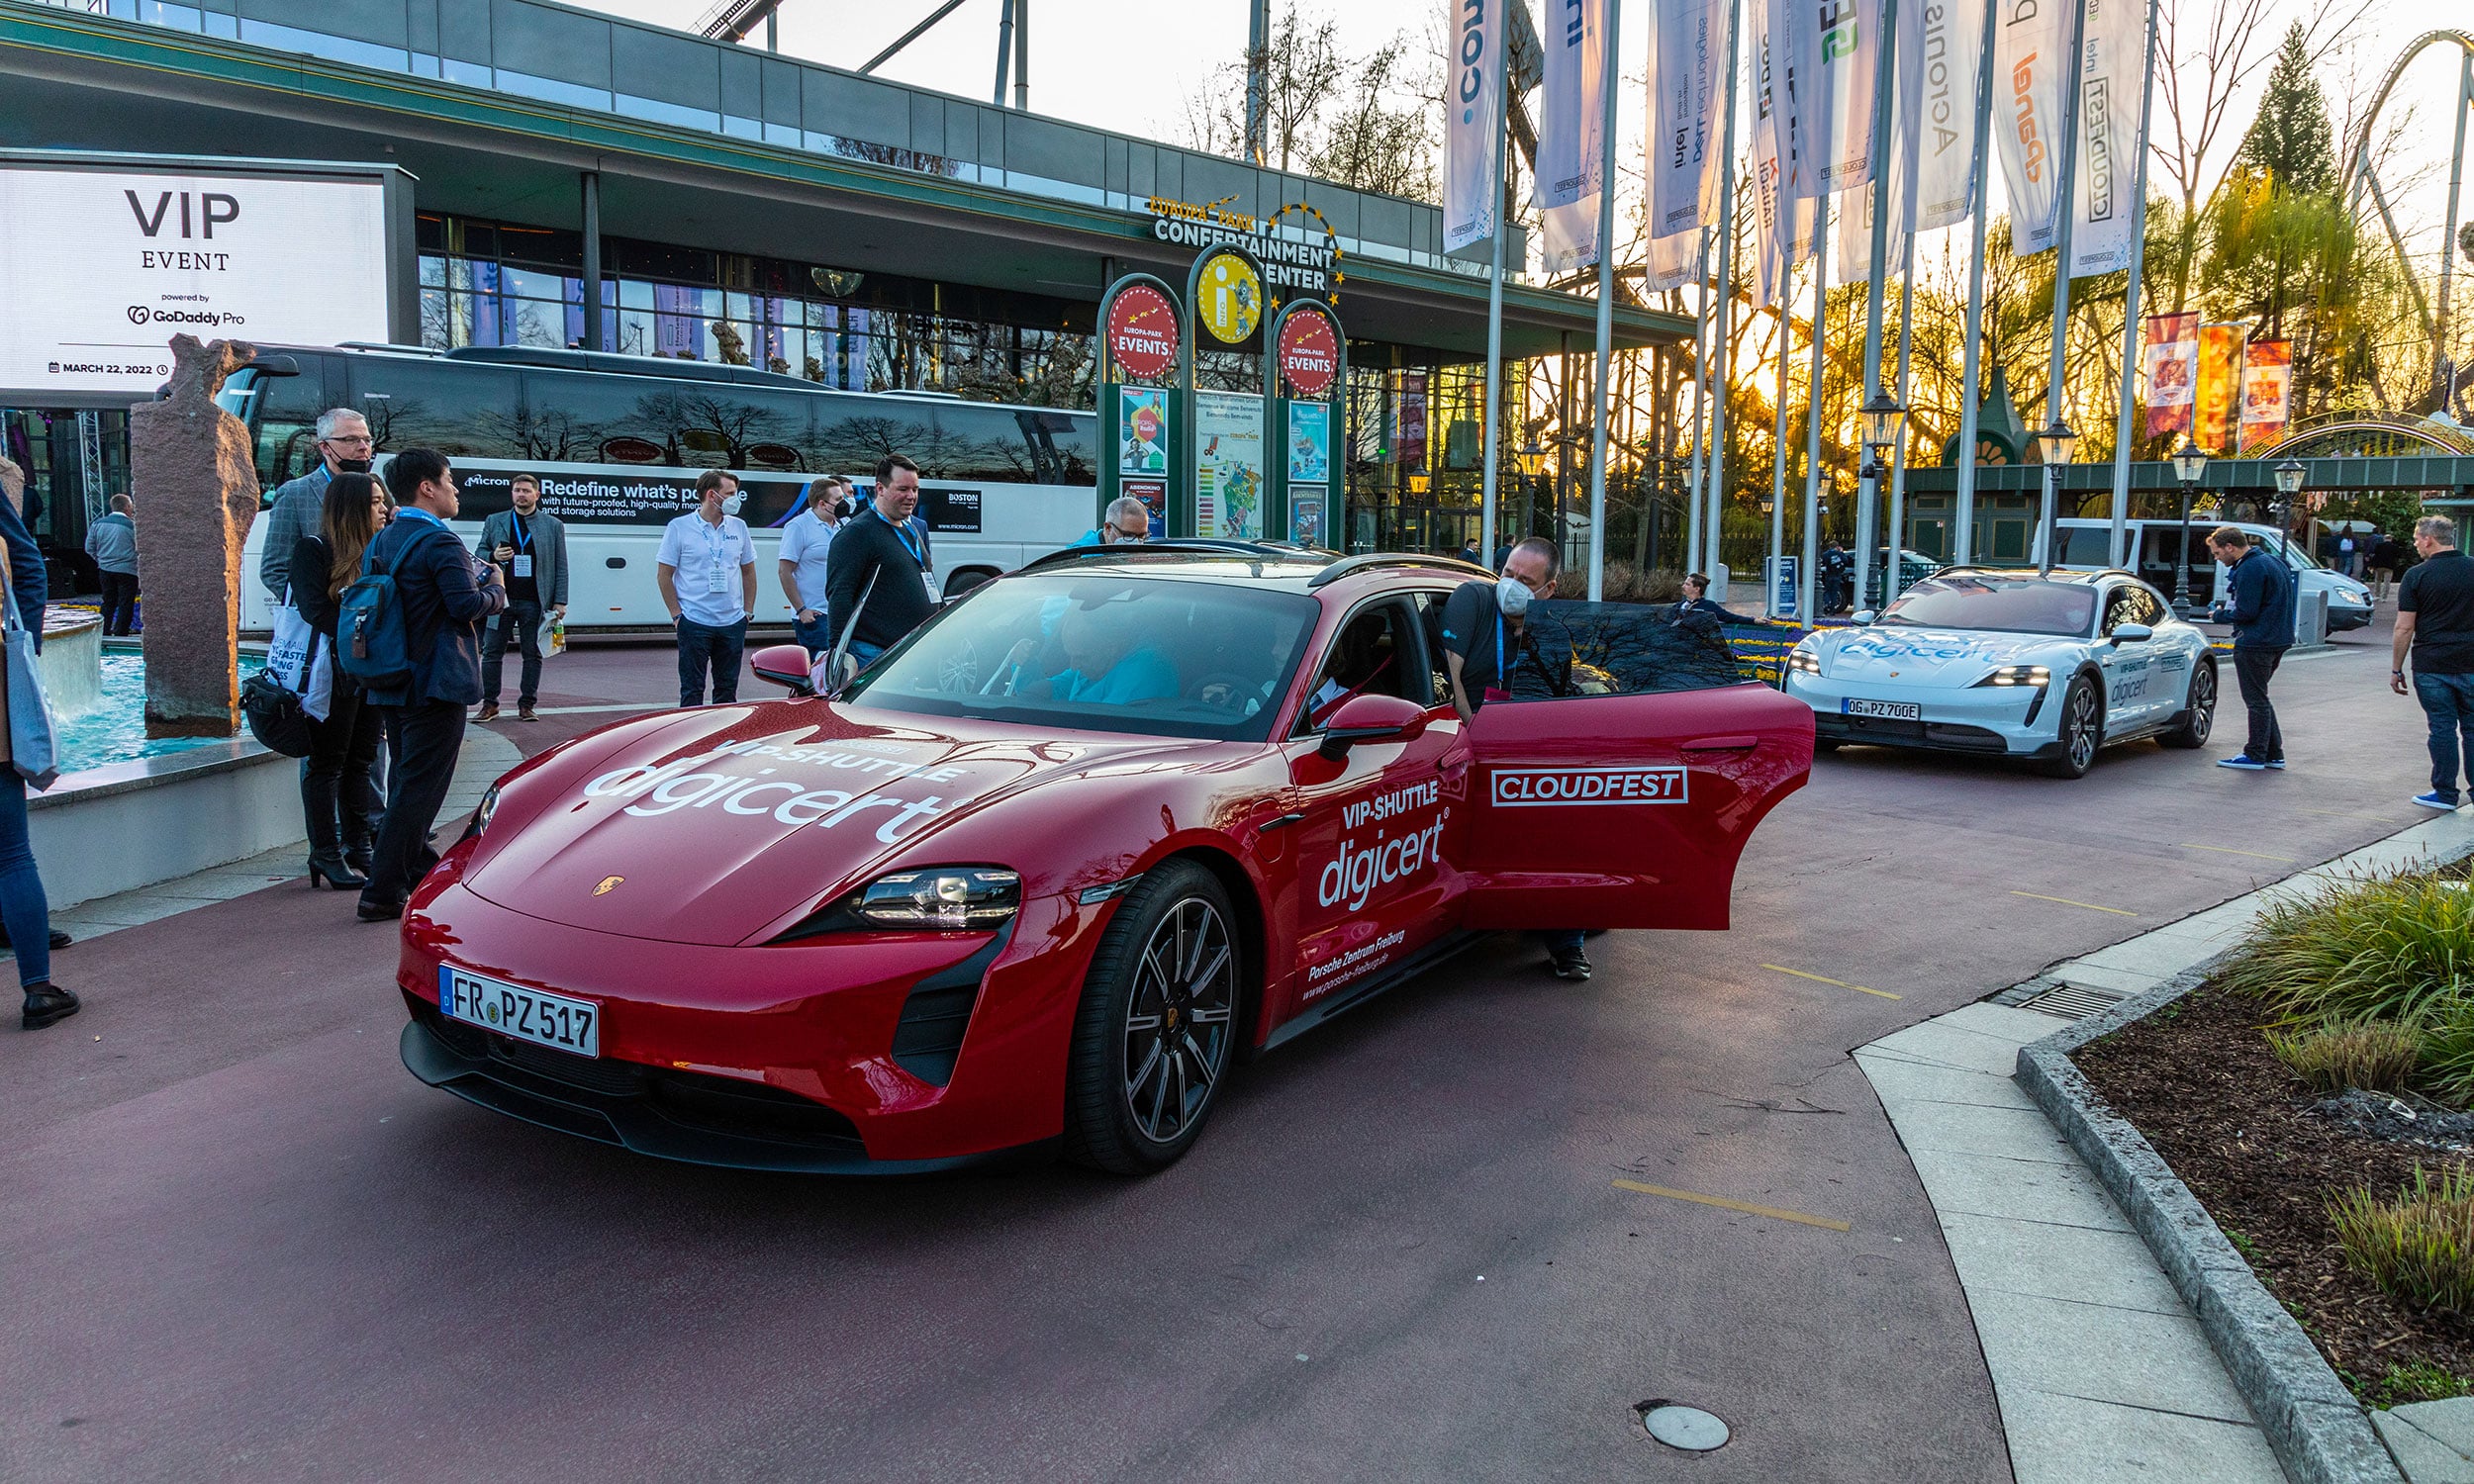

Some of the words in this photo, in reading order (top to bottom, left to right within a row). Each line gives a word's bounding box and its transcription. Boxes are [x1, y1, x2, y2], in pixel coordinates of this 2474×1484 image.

[124, 189, 240, 239] VIP
[1150, 195, 1208, 223] EUROPA
[1218, 210, 1255, 232] PARK
[142, 250, 230, 271] EVENT
[161, 293, 198, 302] powered
[199, 293, 210, 303] by
[153, 310, 221, 326] GoDaddy
[223, 312, 245, 325] Pro
[1123, 326, 1163, 337] EUROPA-PARK
[1118, 335, 1169, 356] EVENTS
[1291, 347, 1325, 356] EUROPA-PARK
[63, 363, 104, 374] MARCH
[106, 364, 123, 375] 22,
[125, 365, 152, 375] 2022
[1287, 356, 1331, 373] EVENTS
[464, 473, 510, 487] Micron
[540, 479, 619, 498] Redefine
[622, 483, 678, 500] what's
[541, 497, 561, 506] with
[563, 498, 629, 510] future-proofed,
[630, 500, 680, 510] high-quality
[681, 502, 702, 510] mem
[948, 493, 979, 502] BOSTON
[541, 507, 559, 515] and
[561, 508, 595, 517] storage
[596, 508, 636, 517] solutions
[2112, 675, 2147, 706] digicert
[1849, 700, 1863, 713] OG
[1870, 702, 1885, 715] PZ
[1887, 703, 1917, 718] 700E
[714, 739, 969, 784] VIP-SHUTTLE
[1498, 774, 1680, 799] CLOUDFEST
[584, 756, 943, 844] digicert
[1342, 780, 1438, 830] VIP-SHUTTLE
[1318, 813, 1444, 912] digicert
[1308, 957, 1342, 982] Porsche
[1342, 943, 1376, 967] Zentrum
[1375, 929, 1405, 951] Freiburg
[1302, 952, 1389, 1001] www.porsche-freiburg.de
[454, 976, 485, 1021] FR
[501, 989, 534, 1036] PZ
[539, 1000, 593, 1048] 517
